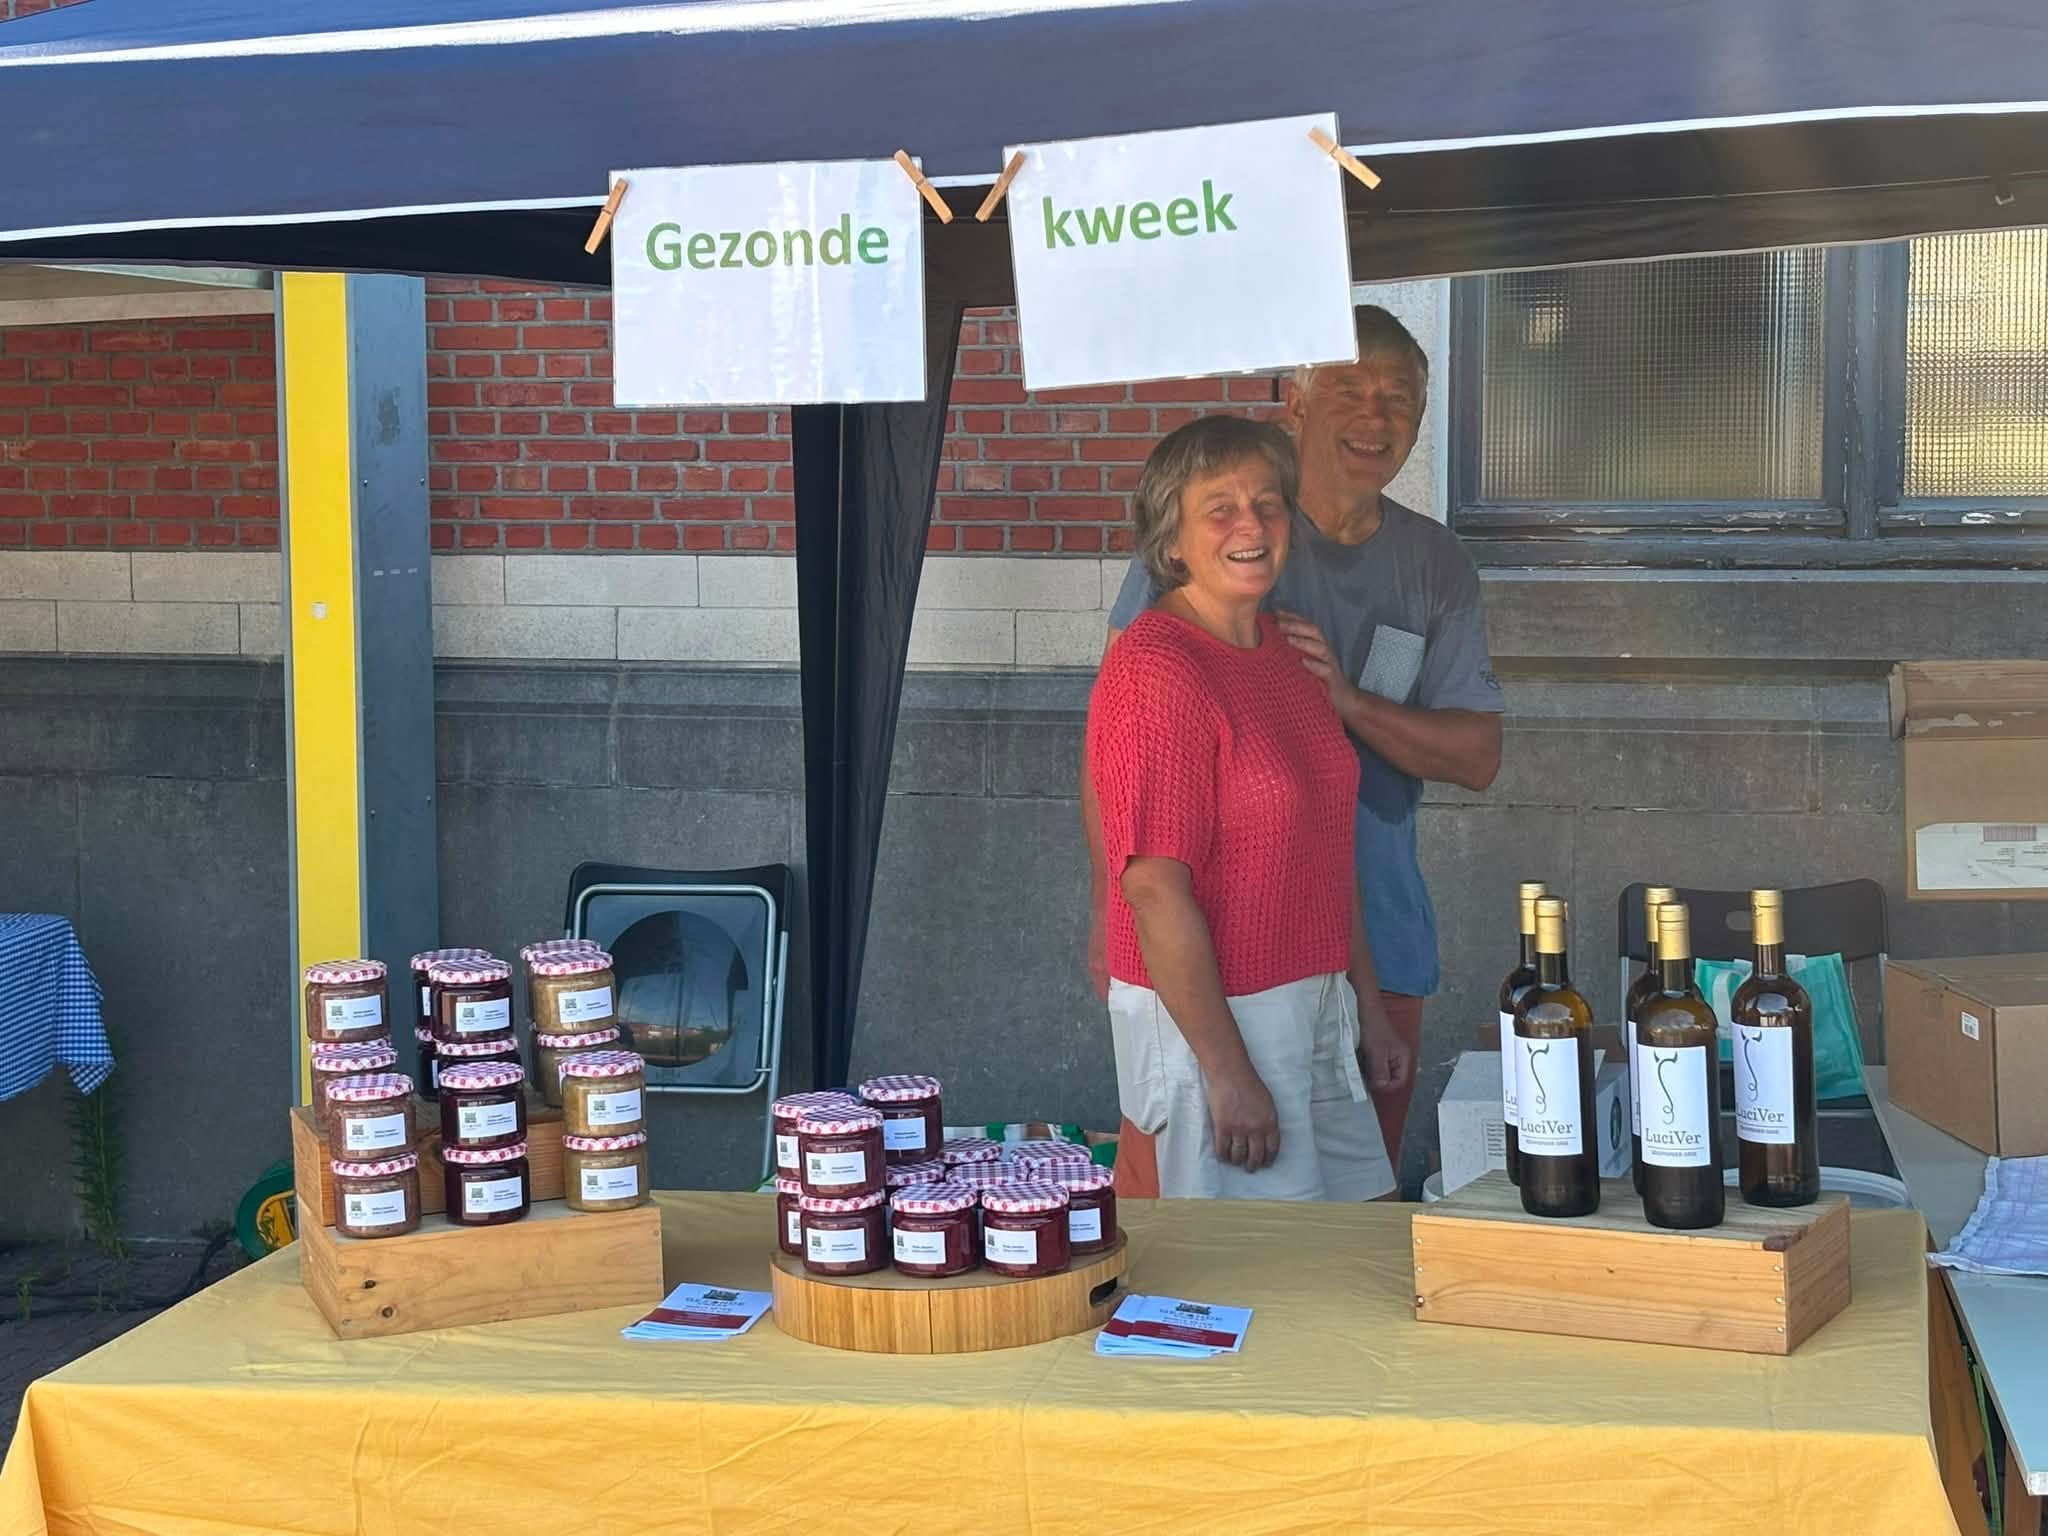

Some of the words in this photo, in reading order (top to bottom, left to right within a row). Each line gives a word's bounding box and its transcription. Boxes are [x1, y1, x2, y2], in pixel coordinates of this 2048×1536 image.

[1043, 180, 1237, 250] kweek
[646, 214, 890, 271] Gezonde
[1736, 1103, 1785, 1122] LuciVer
[1520, 1117, 1574, 1134] LuciVer
[1645, 1127, 1702, 1145] LuciVer
